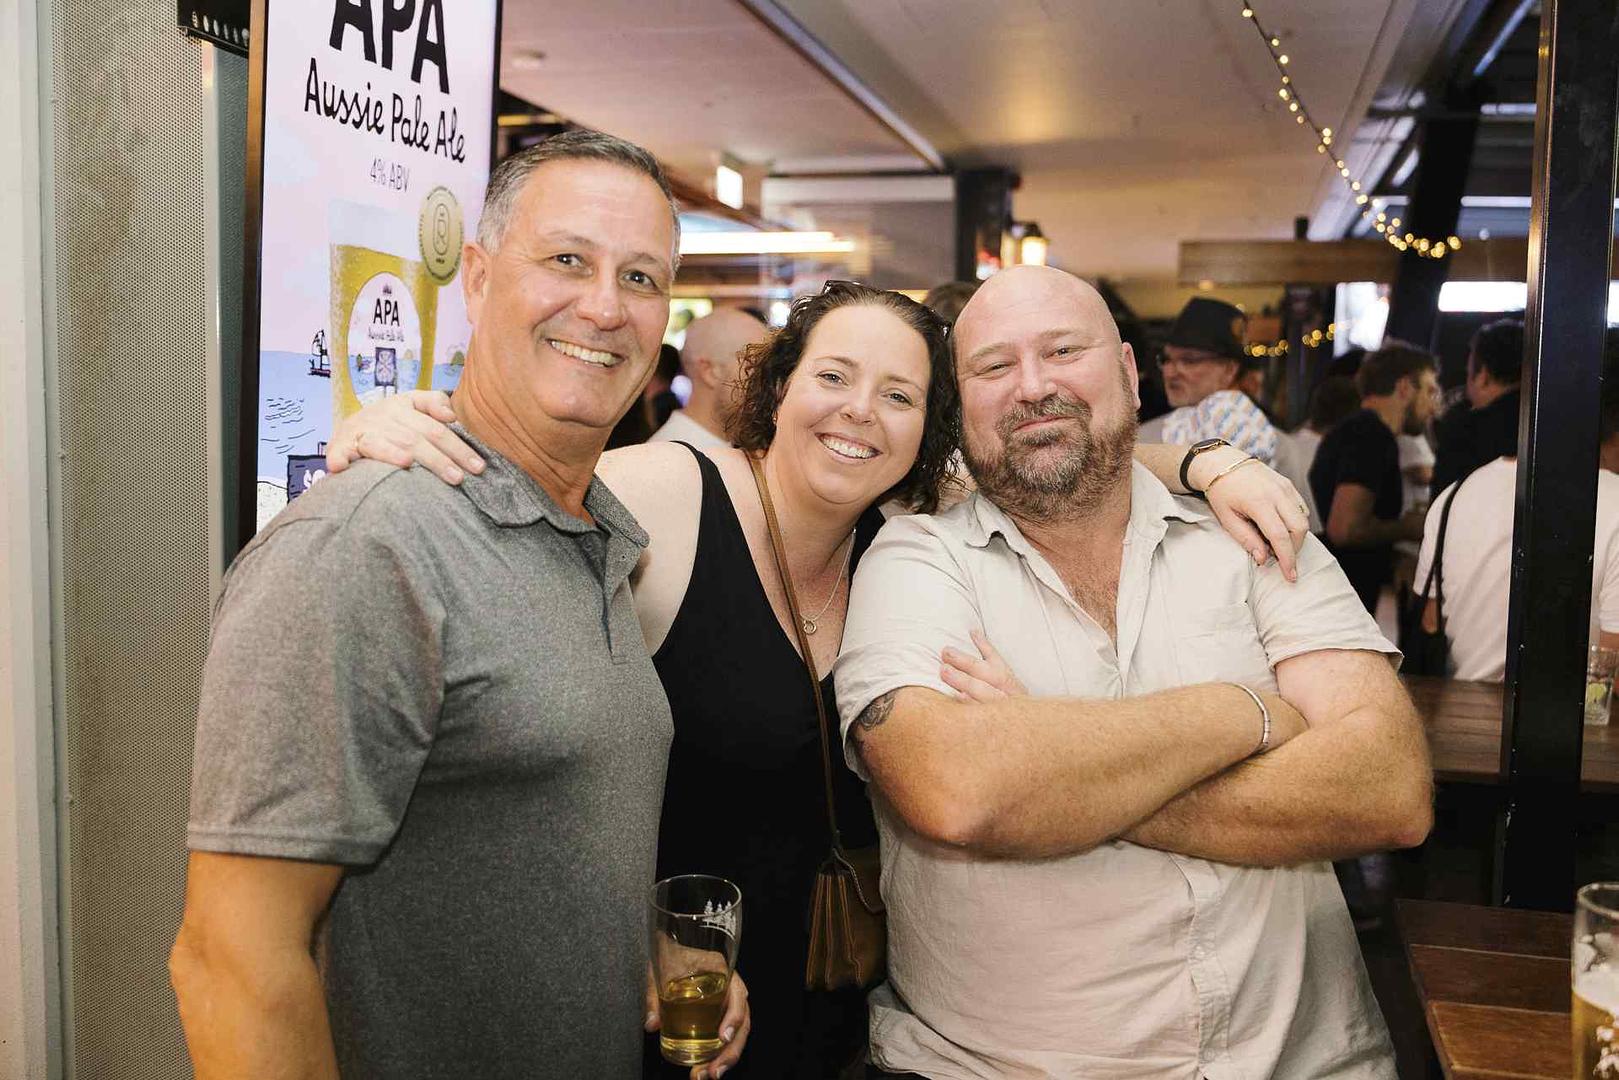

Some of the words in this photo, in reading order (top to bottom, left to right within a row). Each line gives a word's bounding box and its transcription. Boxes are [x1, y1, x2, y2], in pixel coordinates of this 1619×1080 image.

[304, 57, 384, 135] Aussie
[391, 92, 430, 152] Pale
[434, 106, 465, 163] Ale
[370, 157, 386, 185] 4%
[389, 162, 409, 192] ABV
[372, 298, 400, 326] APA
